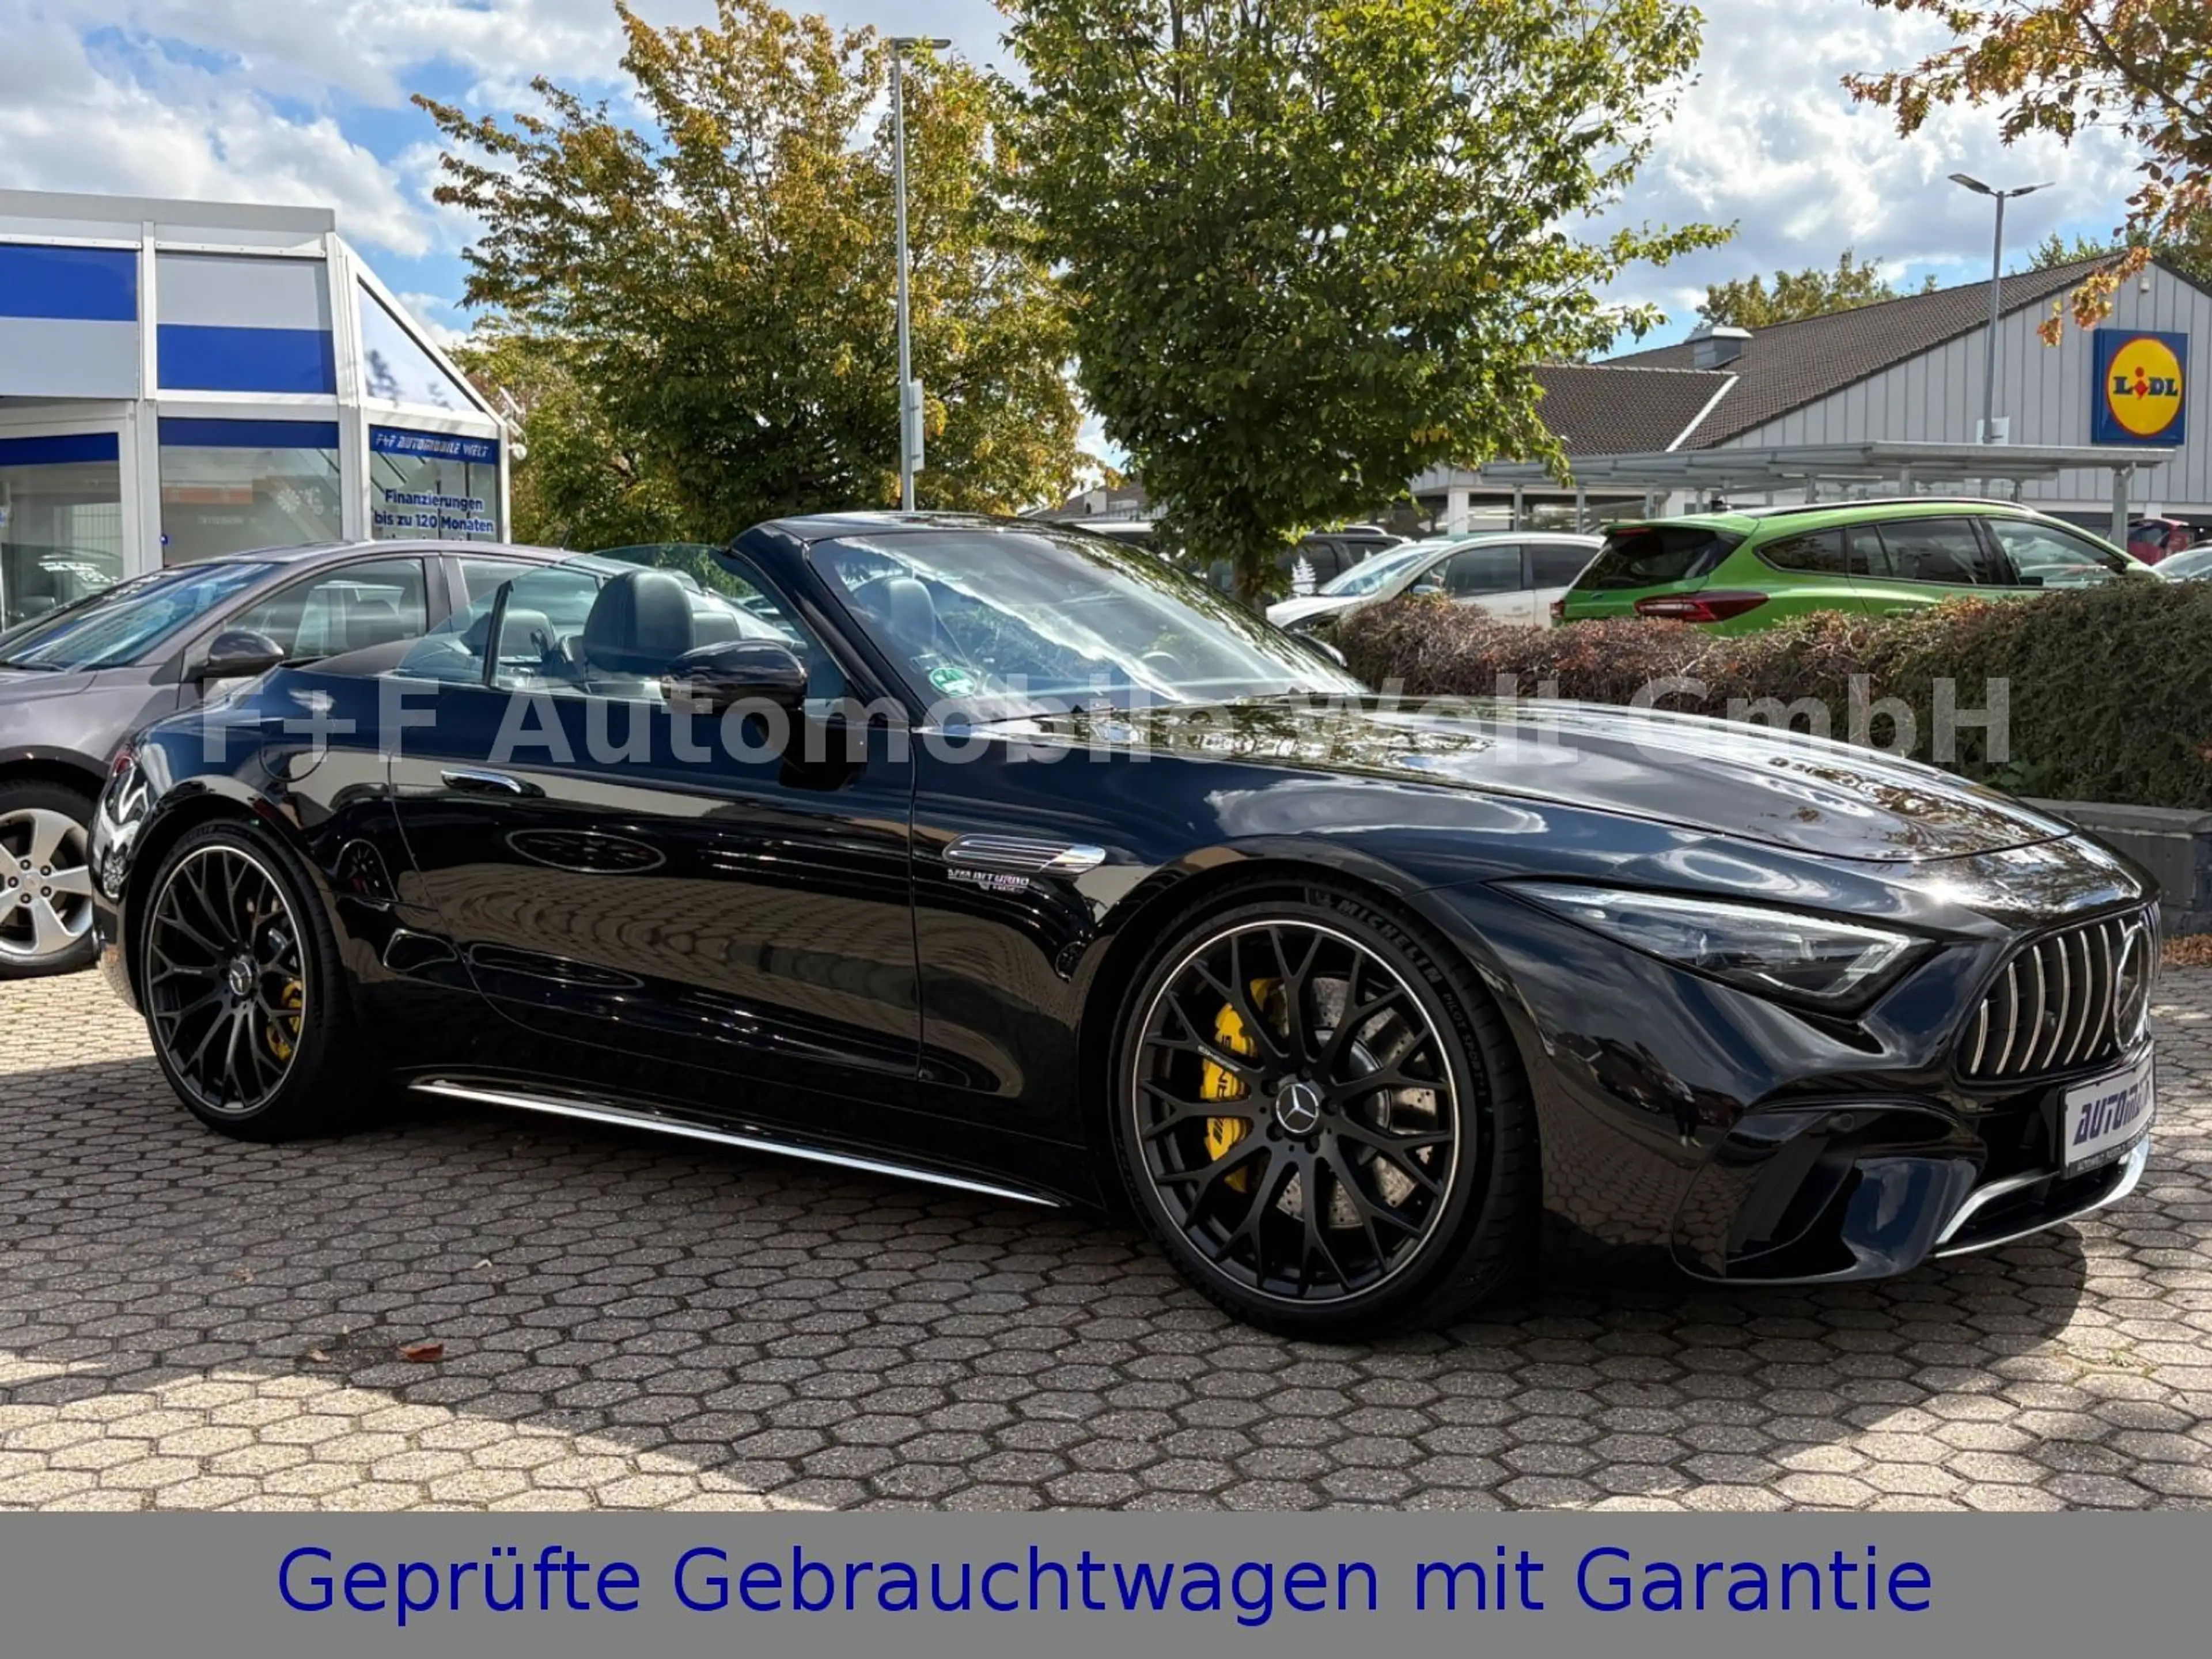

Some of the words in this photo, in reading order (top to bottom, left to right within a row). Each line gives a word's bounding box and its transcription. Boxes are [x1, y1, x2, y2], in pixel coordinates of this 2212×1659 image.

[384, 488, 483, 513] Finanzierungen
[374, 511, 393, 526] bis
[396, 514, 412, 527] zu
[415, 513, 438, 529] 120
[440, 515, 494, 532] Monaten
[1336, 899, 1444, 984] MICHELIN
